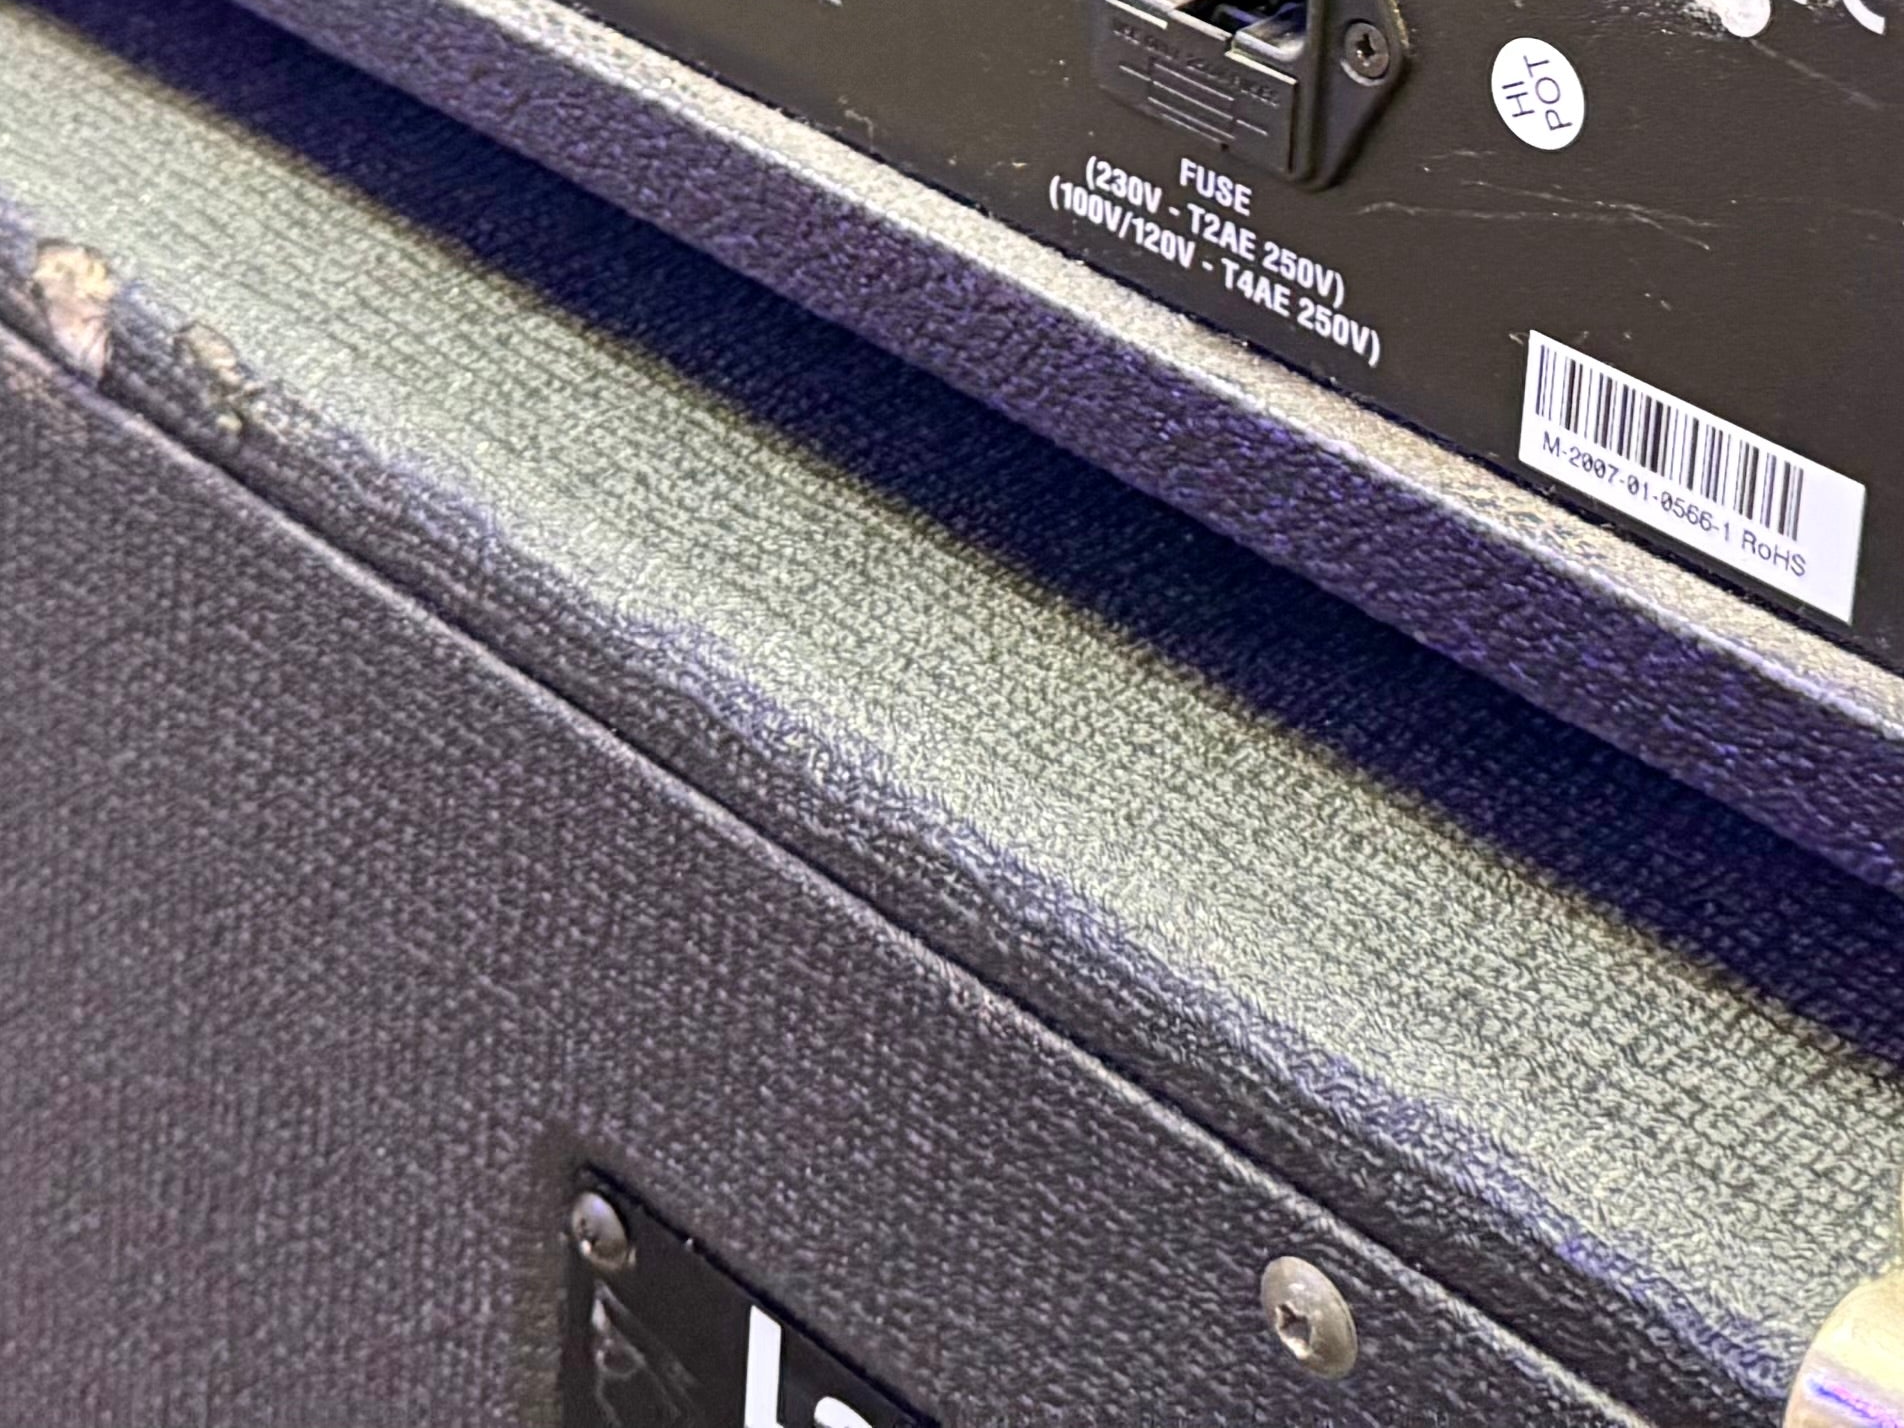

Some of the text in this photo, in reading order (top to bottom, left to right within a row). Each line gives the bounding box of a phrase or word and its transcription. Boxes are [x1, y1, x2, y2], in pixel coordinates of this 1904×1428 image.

[1501, 80, 1536, 119] HI
[1522, 54, 1574, 132] POT
[1085, 155, 1163, 214] (230V
[1186, 202, 1257, 261] T2AE
[1261, 240, 1346, 310] 250V)
[1179, 157, 1253, 217] FUSE
[1048, 175, 1196, 270] (100V/120V
[1220, 257, 1292, 318] T4AE
[1296, 297, 1381, 369] 250V)
[1541, 429, 1808, 579] M-2007-01-0566-1 RoHS
